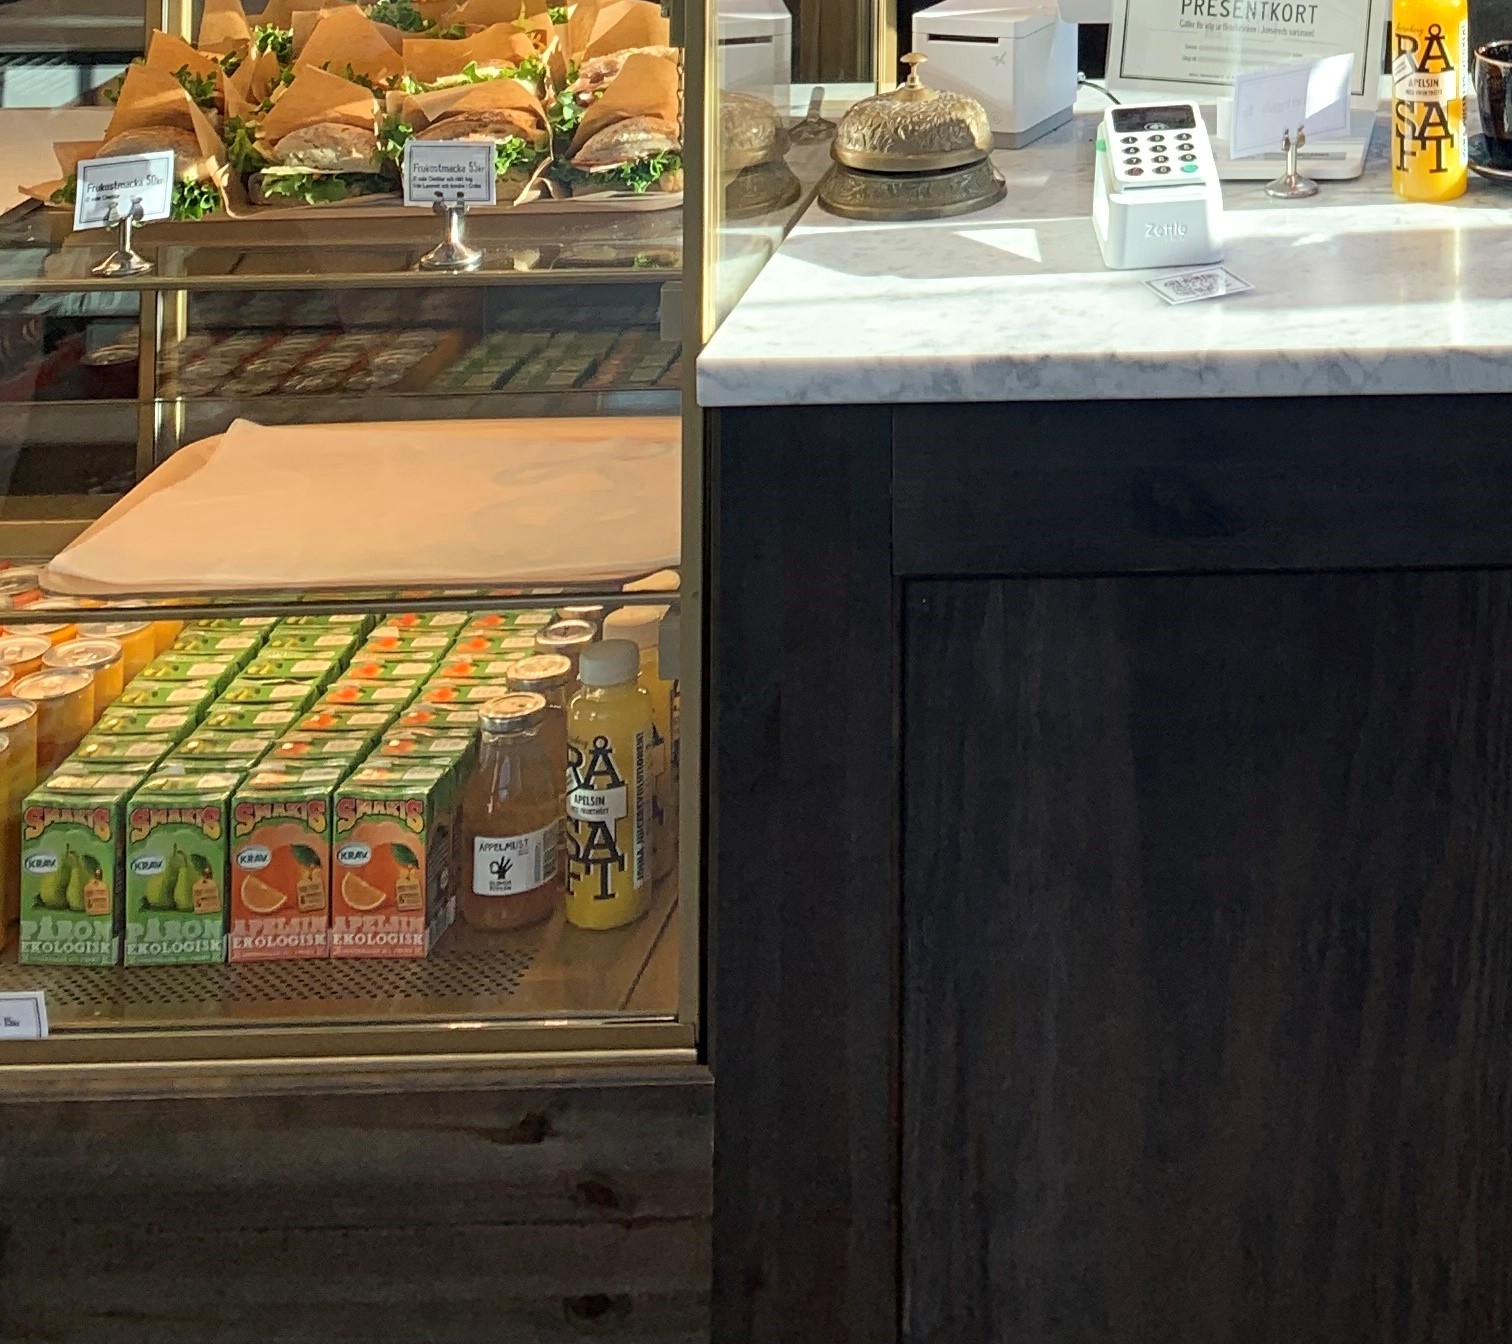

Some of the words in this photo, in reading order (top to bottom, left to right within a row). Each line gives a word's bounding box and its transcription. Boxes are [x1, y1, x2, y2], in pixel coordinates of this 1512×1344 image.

[1407, 78, 1439, 88] APELSIN
[412, 163, 466, 173] Frukostmacka
[87, 178, 143, 194] Frukostmacka
[1143, 220, 1188, 239] Zettle
[573, 794, 606, 807] APELSIN
[234, 799, 328, 838] SMAKIS
[336, 797, 425, 834] SMAKIS
[24, 805, 112, 842] SMAKIS
[130, 805, 222, 844] SMAKIS
[239, 853, 268, 863] KRAV
[339, 850, 368, 860] KRAV
[28, 859, 57, 869] KRAV
[134, 860, 164, 871] KRAV
[231, 934, 328, 949] EKOLOGISK
[332, 932, 424, 946] EKOLOGISK
[20, 941, 112, 955] EKOLOGISK
[126, 939, 223, 955] EKOLOGISK
